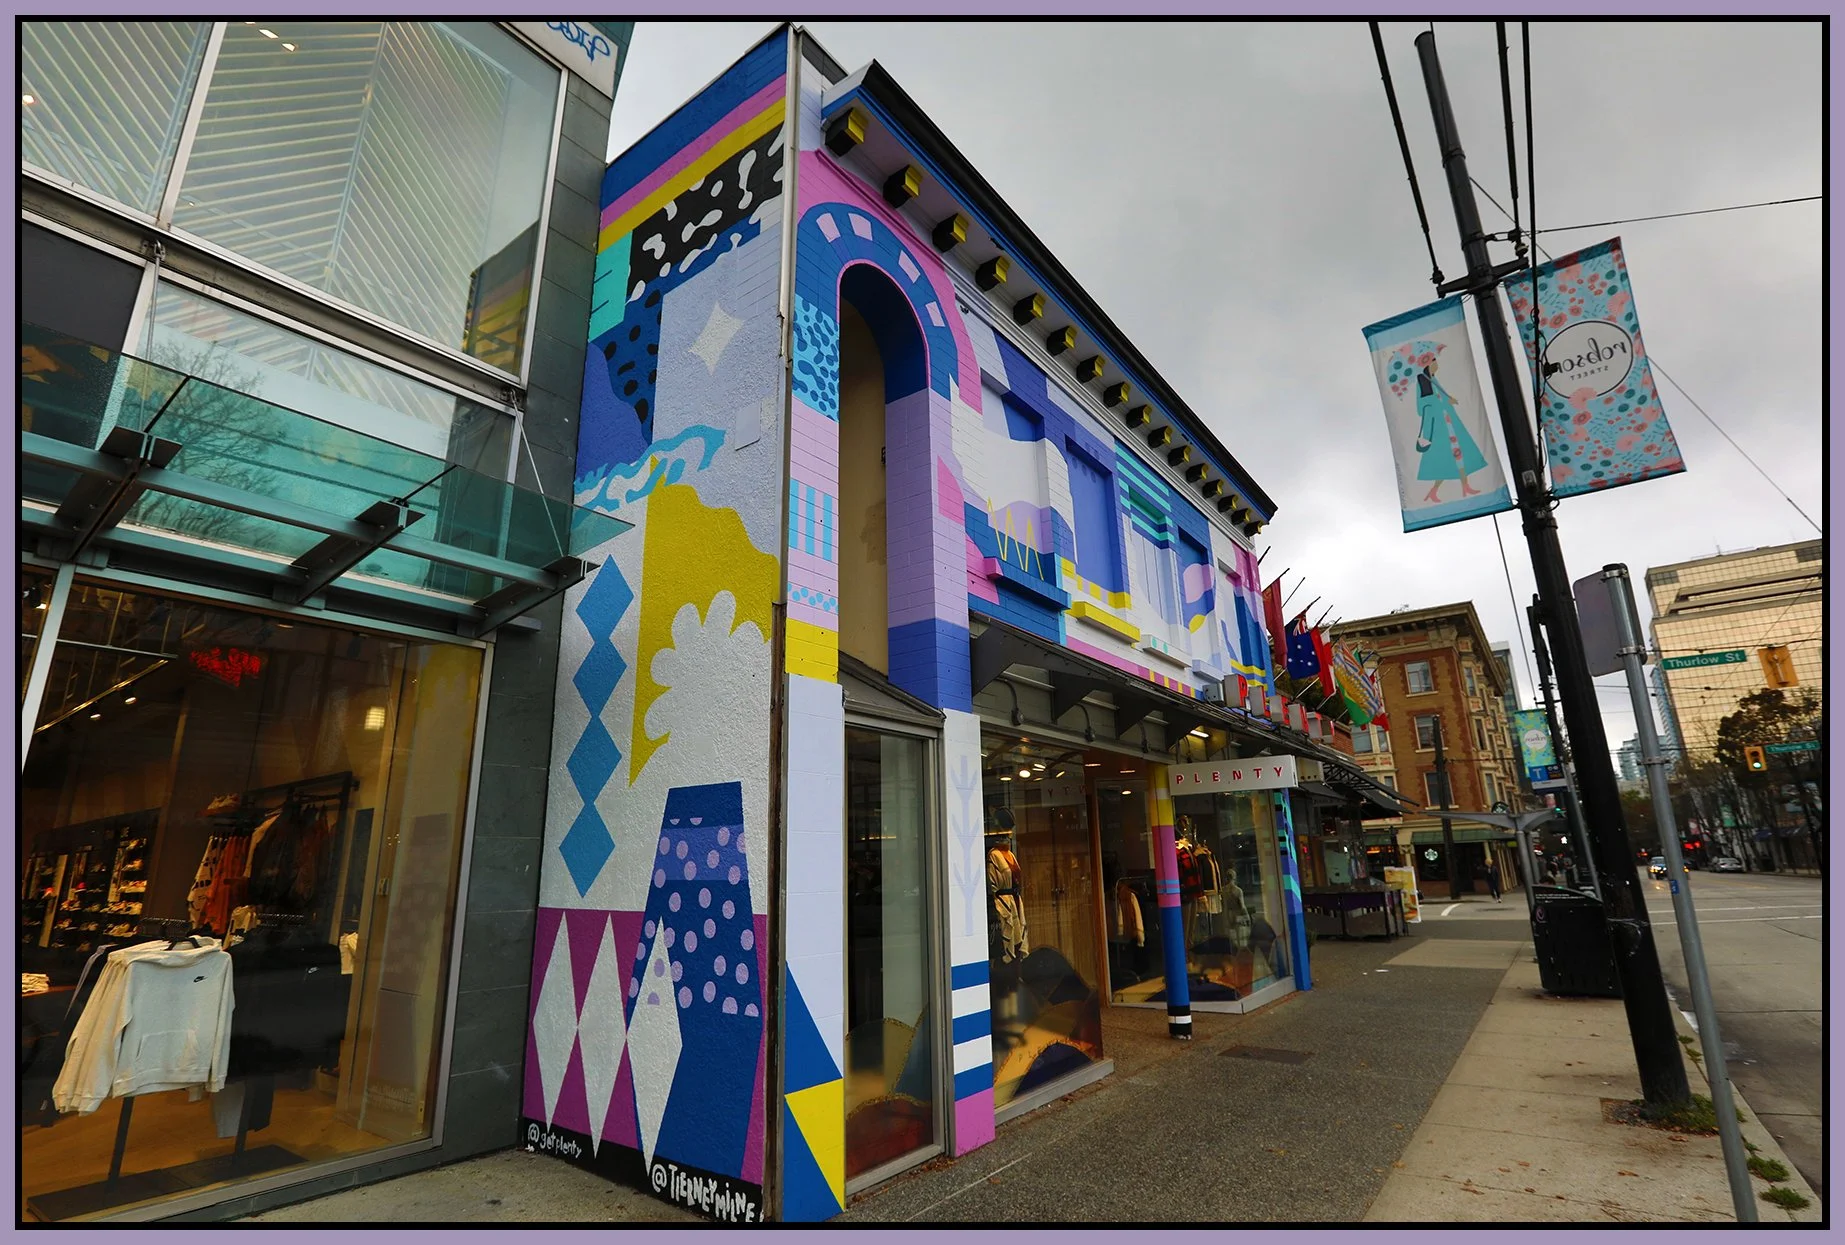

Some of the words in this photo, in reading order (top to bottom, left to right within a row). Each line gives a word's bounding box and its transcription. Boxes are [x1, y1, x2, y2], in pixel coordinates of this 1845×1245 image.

[1667, 656, 1719, 668] Thurlow
[1725, 652, 1741, 662] St
[1176, 766, 1282, 784] PLENTY
